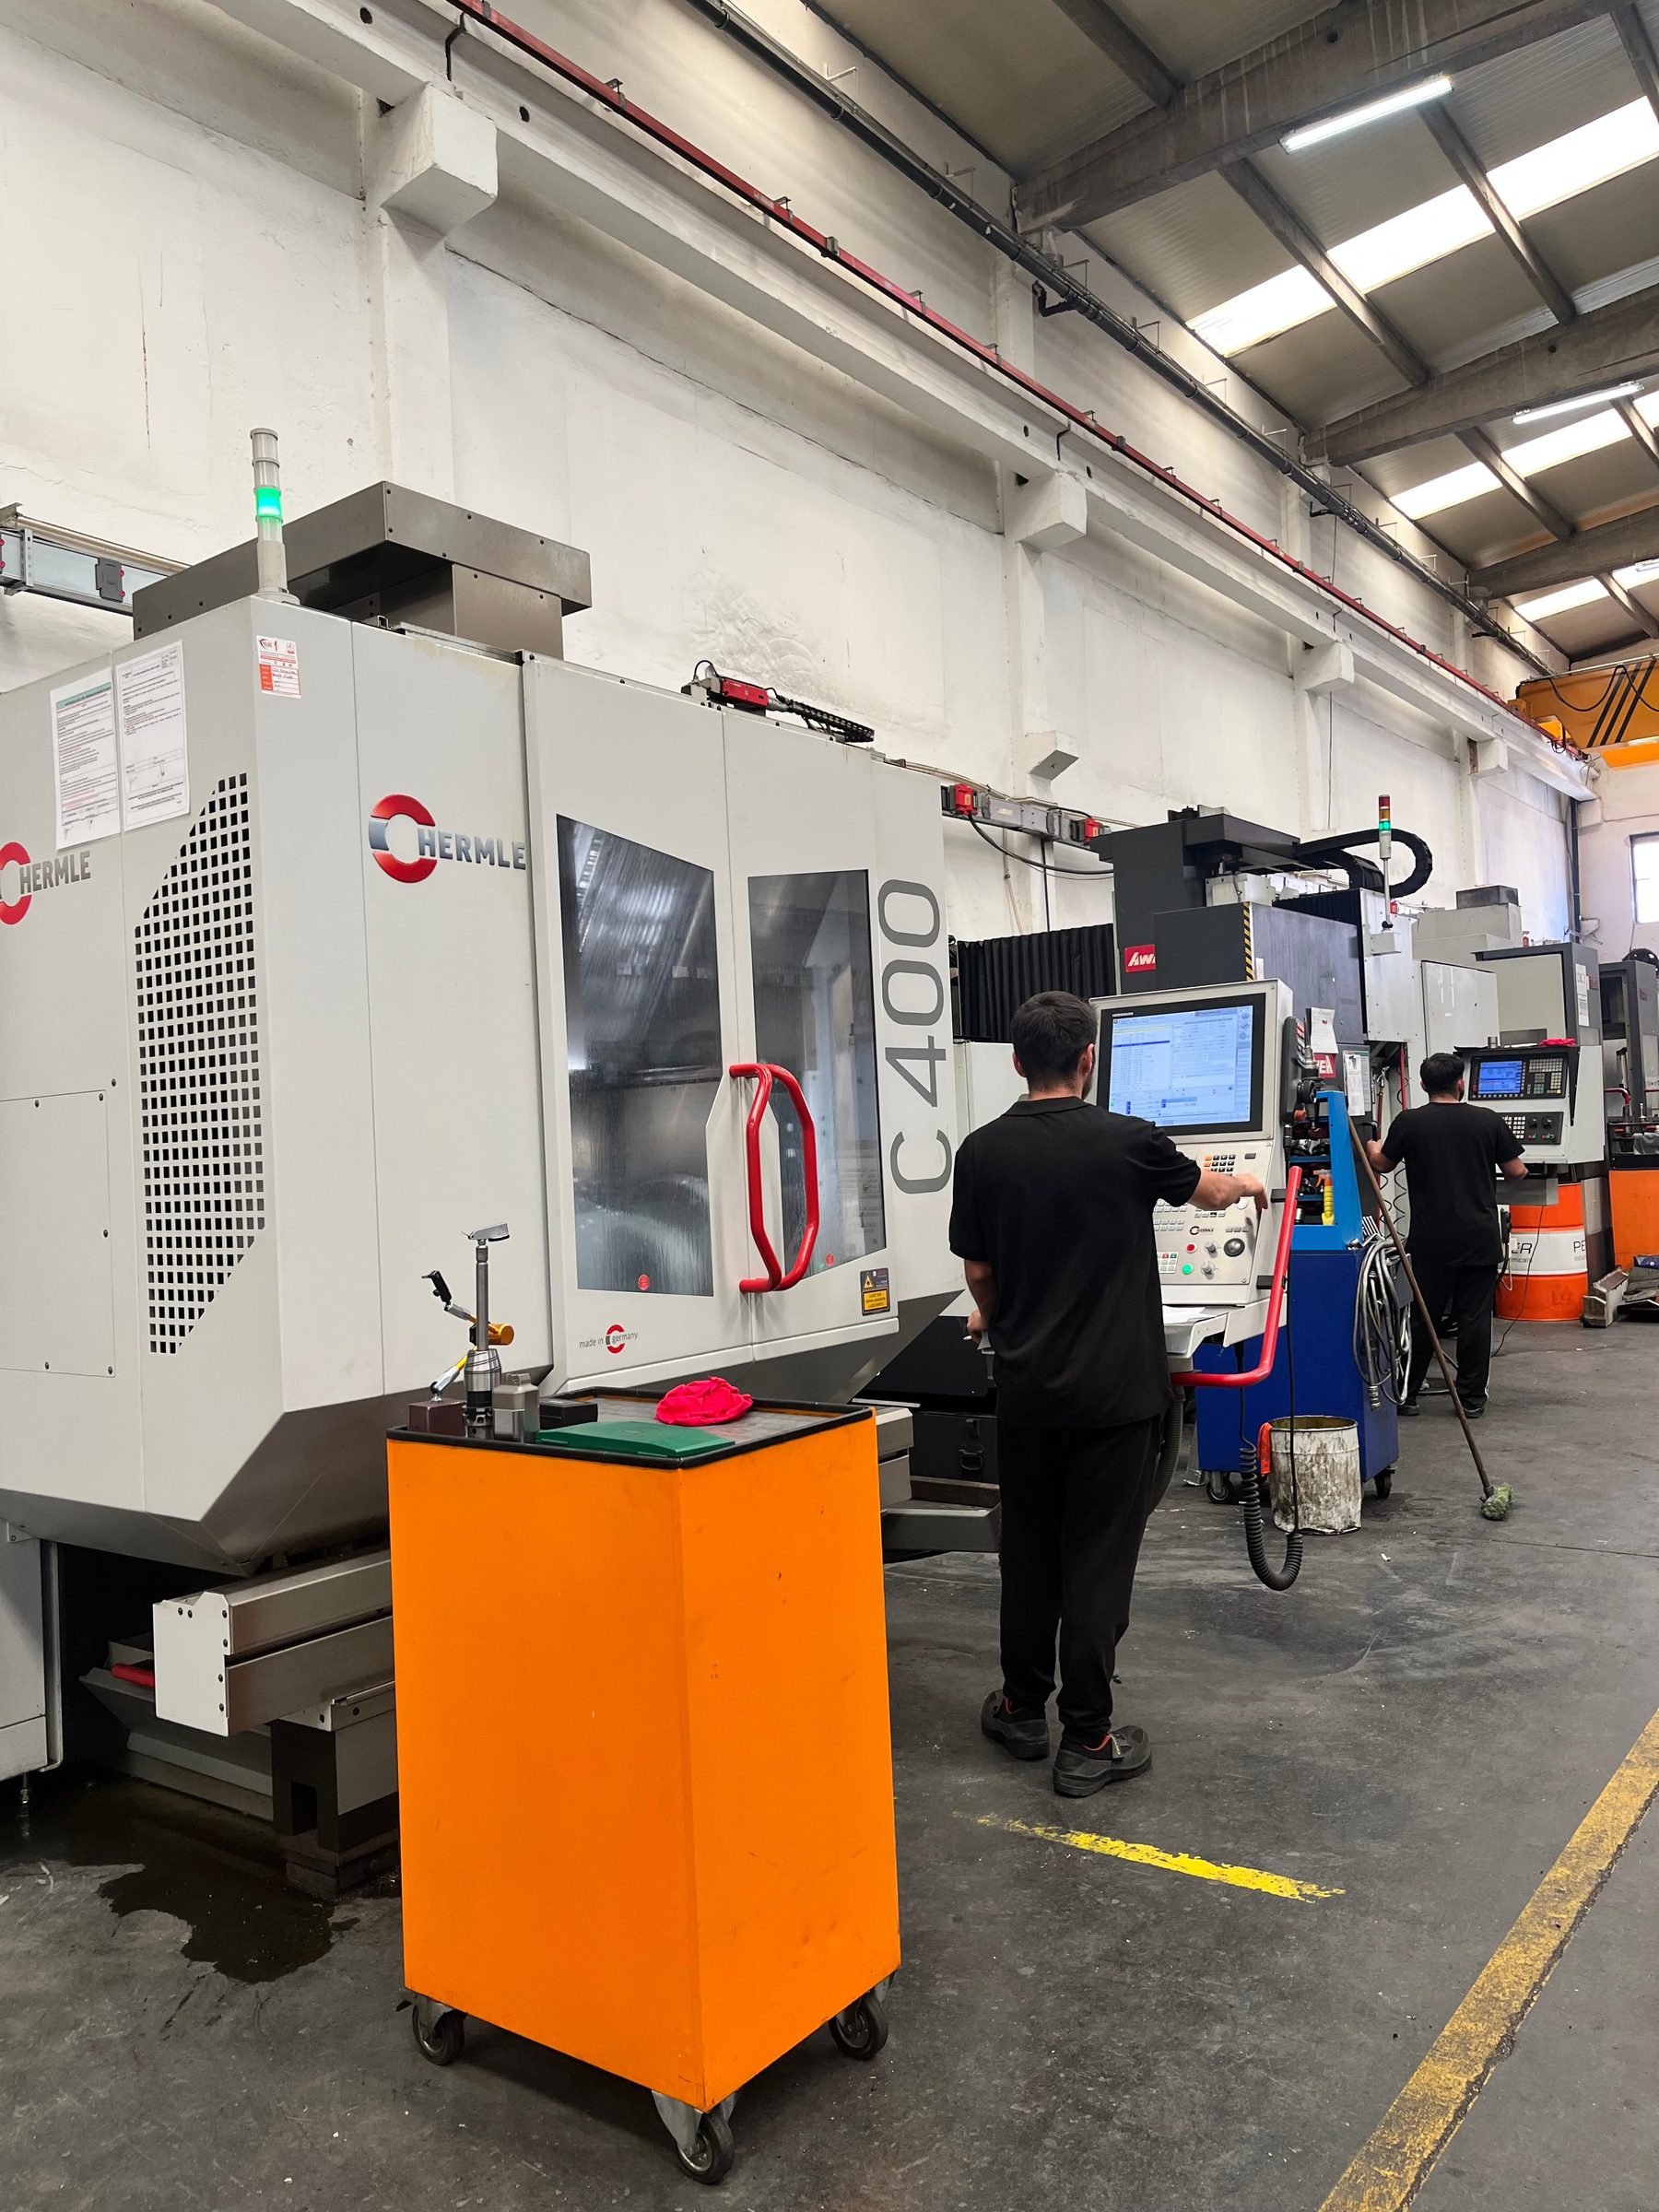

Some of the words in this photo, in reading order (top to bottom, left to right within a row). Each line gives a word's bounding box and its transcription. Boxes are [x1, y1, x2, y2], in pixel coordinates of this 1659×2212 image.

[418, 828, 526, 871] HERMLE
[19, 850, 91, 895] HERMLE
[1128, 951, 1156, 967] AW
[579, 1338, 596, 1348] made
